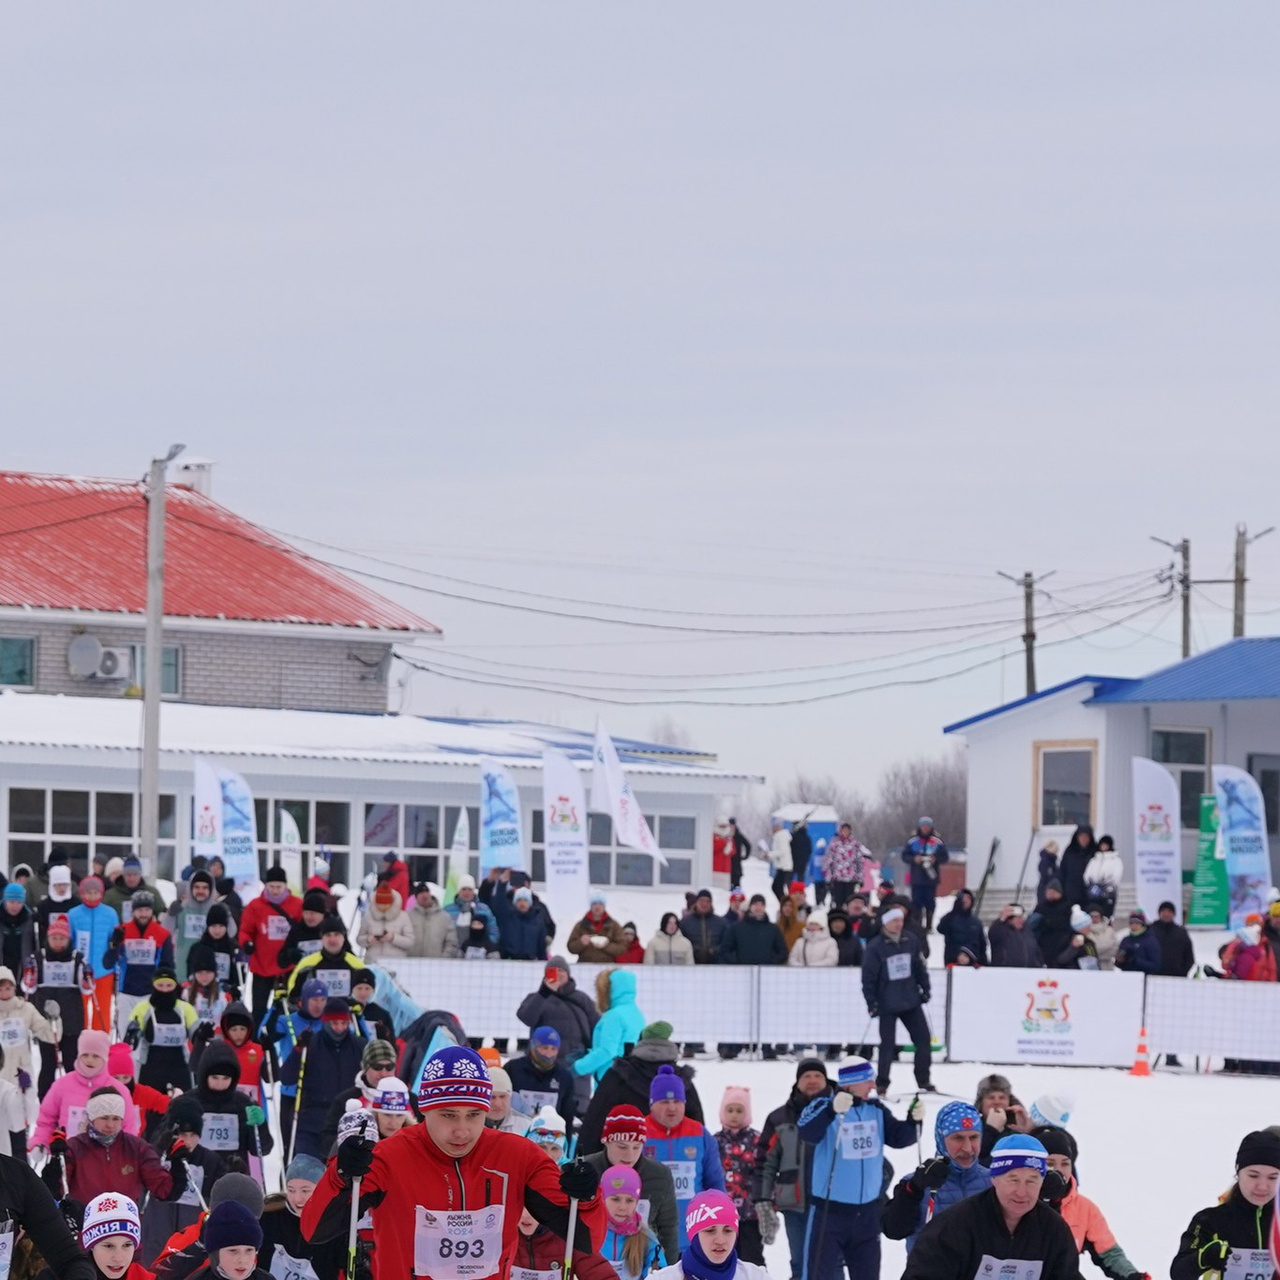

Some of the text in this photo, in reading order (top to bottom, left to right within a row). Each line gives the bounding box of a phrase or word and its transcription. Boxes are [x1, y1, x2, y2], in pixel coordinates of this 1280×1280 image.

[209, 1128, 229, 1140] 793
[608, 1132, 637, 1143] 2007
[852, 1137, 873, 1150] 826
[674, 1177, 689, 1190] 00
[83, 1223, 120, 1243] ЫЖНЯ
[448, 1228, 474, 1236] 2024
[439, 1238, 485, 1259] 893
